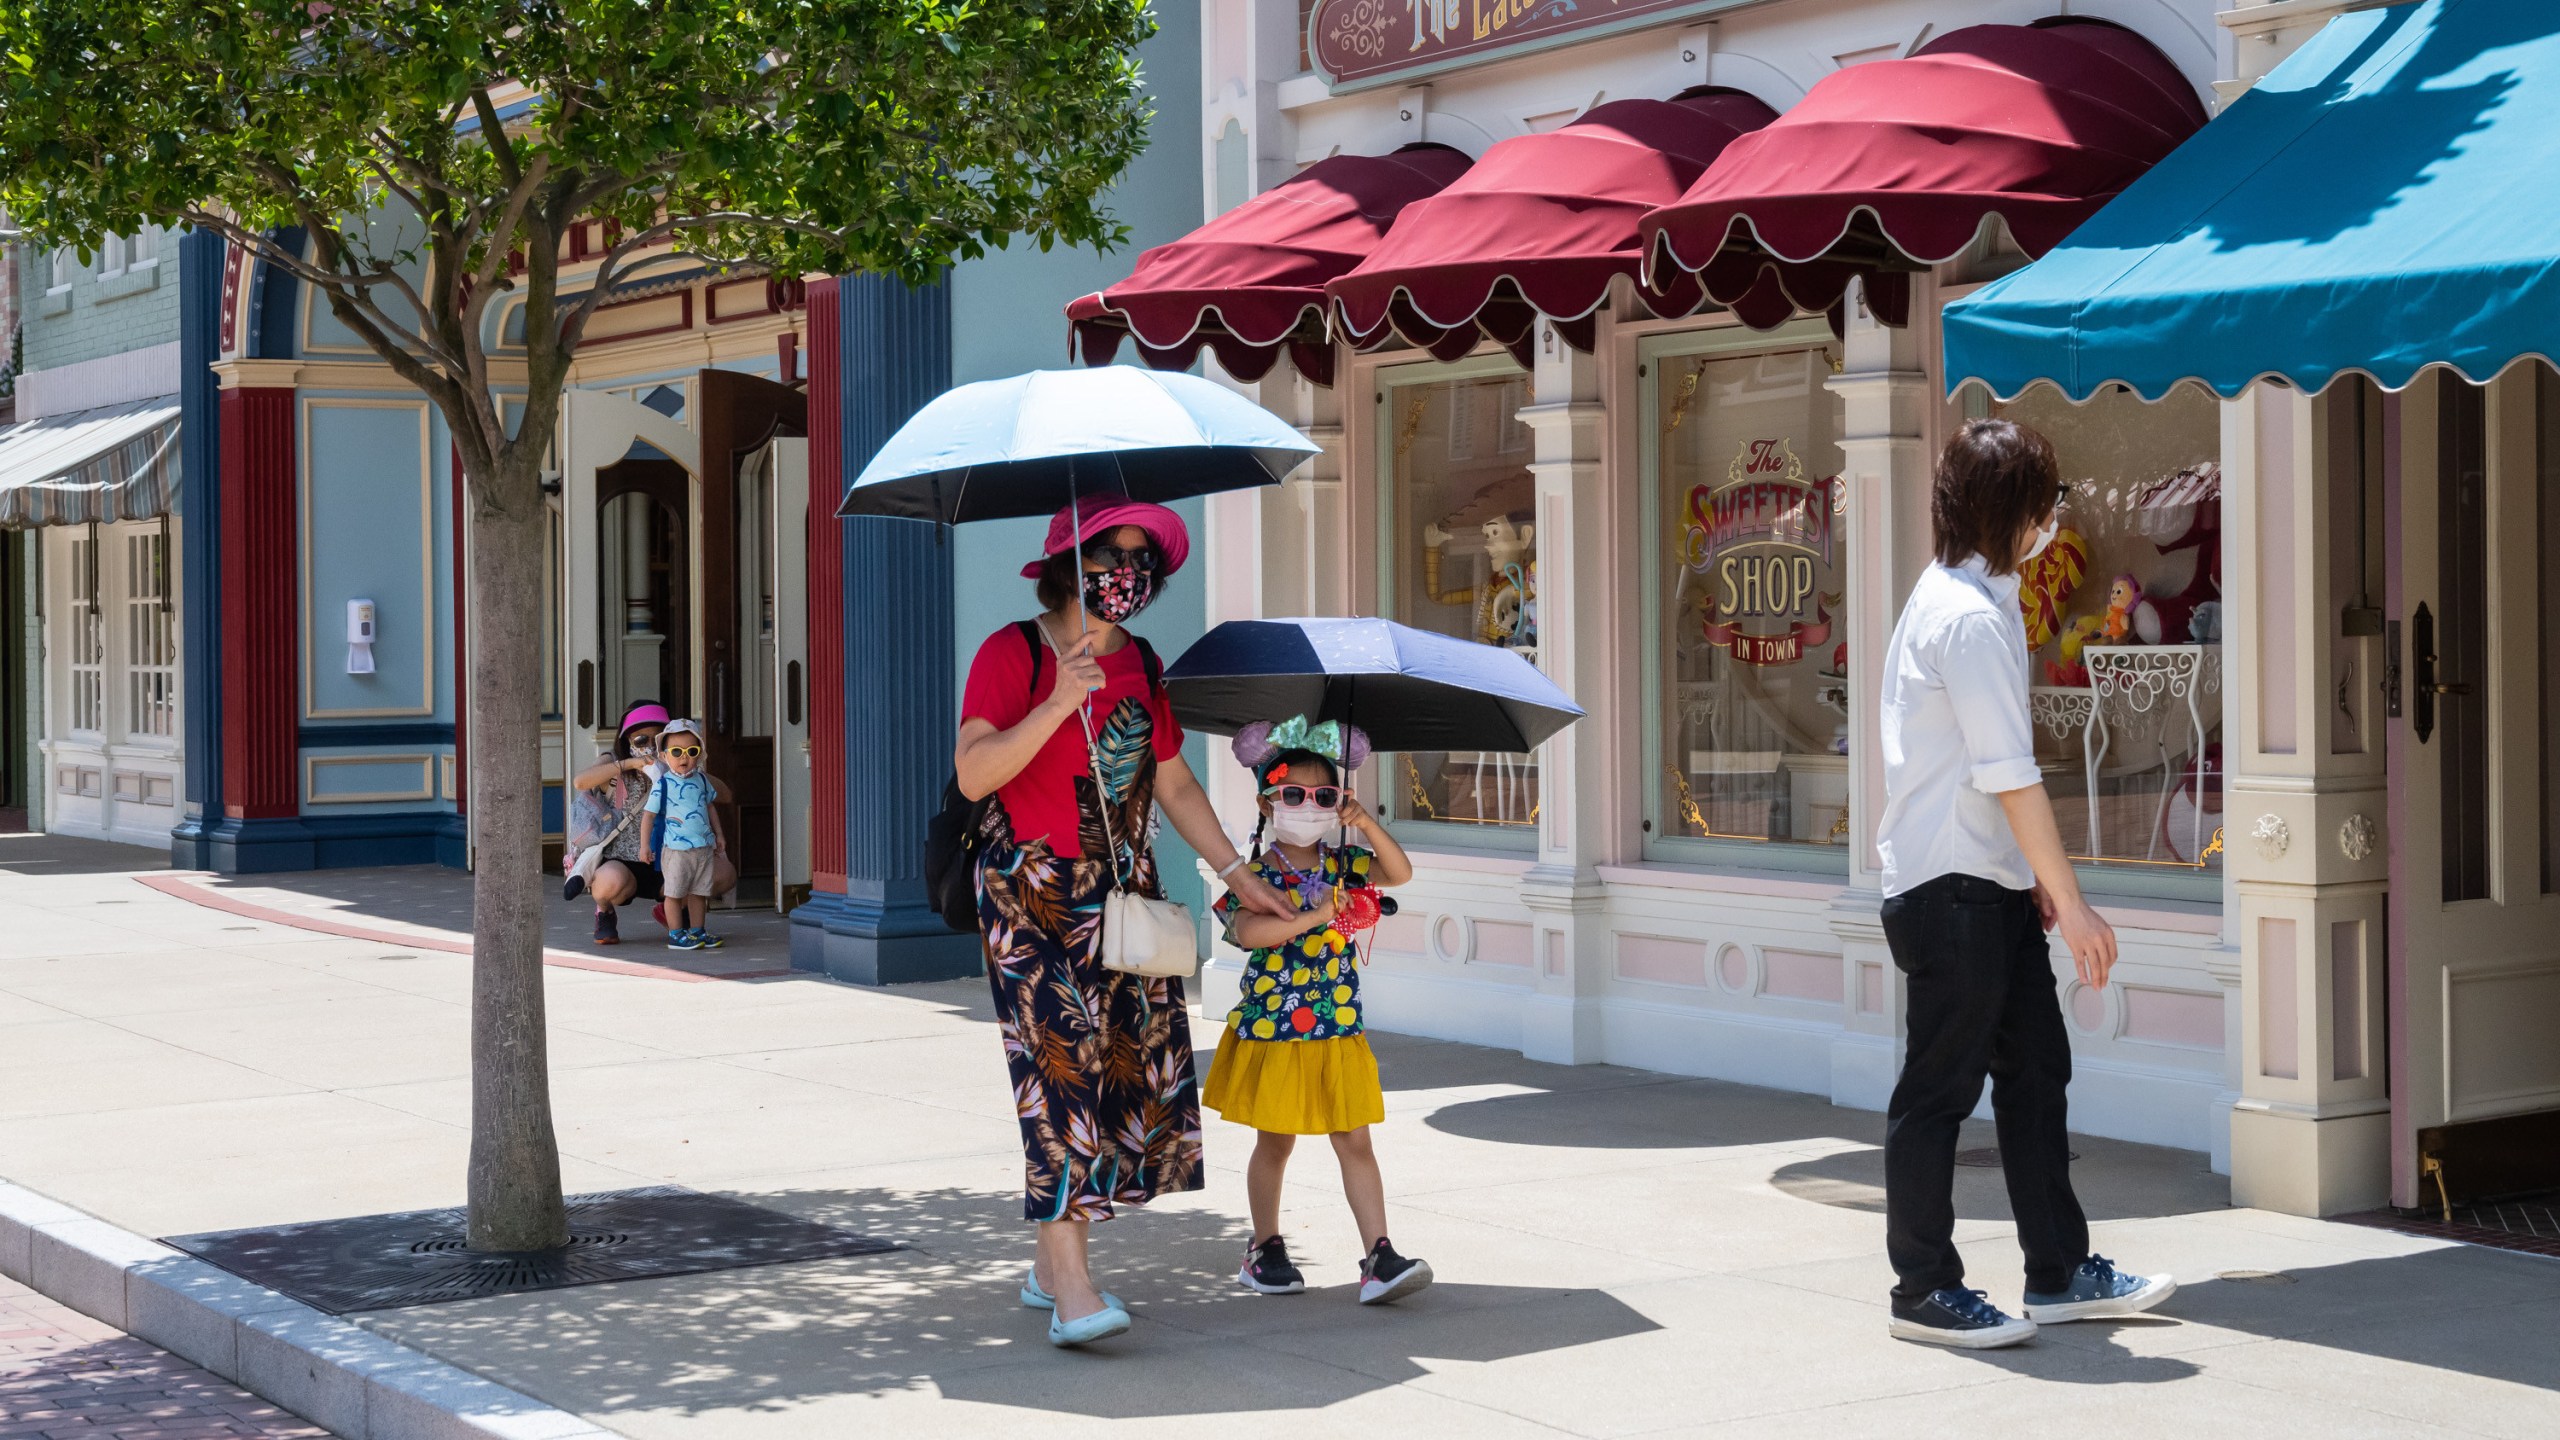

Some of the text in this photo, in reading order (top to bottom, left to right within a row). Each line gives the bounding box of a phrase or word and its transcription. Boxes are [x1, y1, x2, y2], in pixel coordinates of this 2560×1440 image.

[1406, 0, 1460, 52] The
[1746, 438, 1784, 474] The
[1686, 474, 1847, 574] SWEETEST
[1719, 555, 1815, 616] SHOP
[1737, 637, 1796, 661] IN TOWN
